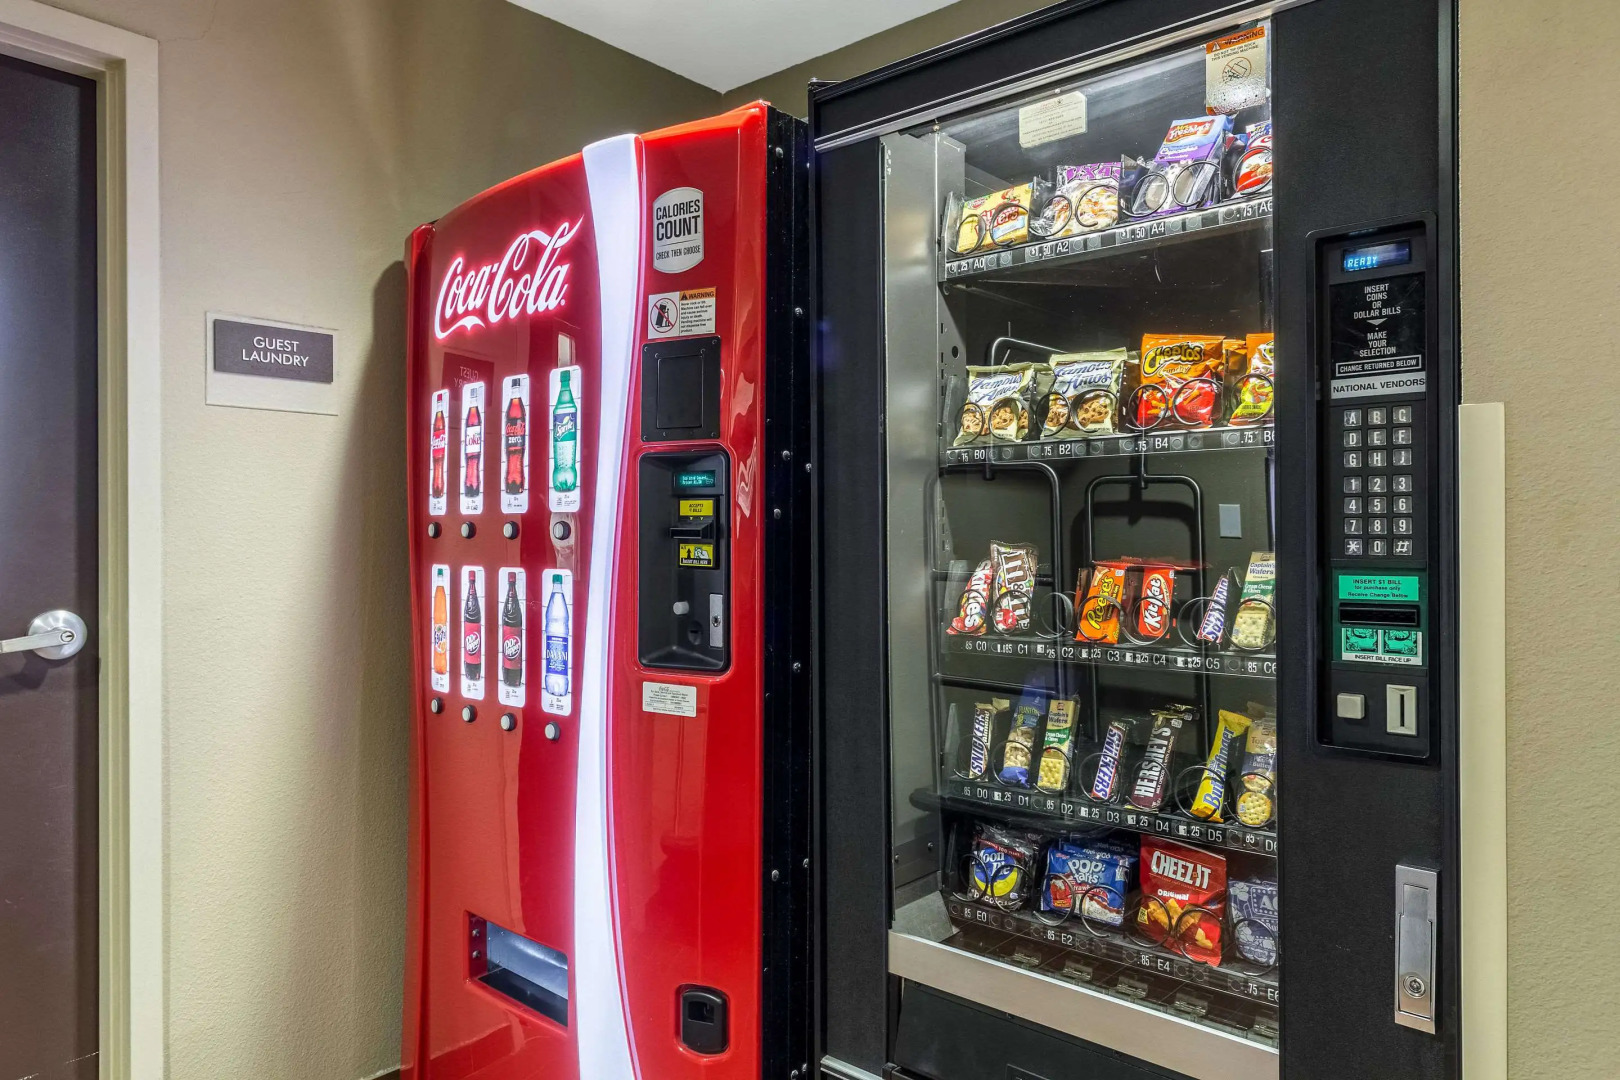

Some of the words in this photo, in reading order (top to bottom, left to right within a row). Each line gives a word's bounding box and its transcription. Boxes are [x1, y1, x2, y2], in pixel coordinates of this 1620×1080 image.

[1224, 28, 1264, 45] WARNING
[656, 199, 700, 221] CALORIES
[656, 215, 700, 242] COUNT
[1151, 222, 1165, 235] A4
[656, 248, 670, 260] CHECK
[670, 246, 682, 258] THEN
[683, 244, 700, 256] CHOOSE
[1056, 240, 1069, 254] A2
[974, 258, 984, 270] A0
[1347, 256, 1378, 267] READY
[434, 214, 584, 339] Coca-Cola
[1364, 283, 1389, 294] INSERT
[688, 291, 714, 299] WARNING
[1366, 292, 1388, 301] COINS
[1372, 301, 1382, 309] OR
[1353, 309, 1380, 319] DOLLAR
[1382, 306, 1401, 315] BILLS
[1367, 331, 1387, 340] MAKE
[253, 336, 300, 352] GUEST
[1368, 339, 1387, 348] YOUR
[1359, 346, 1396, 357] SELECTION
[242, 349, 309, 367] LAUNDRY
[1142, 344, 1204, 376] Cheetos
[1055, 361, 1112, 376] Famous
[1340, 364, 1363, 373] CHANGE
[1364, 361, 1395, 370] RETURNED
[971, 373, 1022, 390] Famous
[1062, 374, 1112, 394] Amos
[1333, 383, 1378, 393] NATIONAL
[1380, 378, 1425, 389] VENDORS
[1349, 412, 1356, 424] A
[1373, 411, 1381, 423] B
[556, 423, 575, 437] Sprite
[1398, 430, 1406, 442] F
[1155, 438, 1168, 449] B4
[1349, 433, 1356, 445] D
[1374, 432, 1380, 443] E
[974, 450, 985, 460] B0
[1059, 444, 1071, 455] B2
[1349, 453, 1356, 465] G
[1374, 452, 1381, 465] H
[1400, 451, 1404, 463] J
[1351, 478, 1355, 490] 1
[1374, 478, 1380, 490] 2
[1399, 477, 1405, 489] 3
[1349, 500, 1356, 511] 4
[1374, 499, 1380, 511] 5
[1399, 498, 1406, 510] 6
[1350, 520, 1356, 531] 7
[1374, 520, 1381, 532] 8
[1399, 520, 1406, 531] 9
[1374, 541, 1380, 552] 0
[1396, 541, 1409, 552] #
[1087, 576, 1114, 630] Reese's
[976, 640, 986, 651] C0
[1018, 644, 1028, 654] C1
[547, 649, 568, 661] DASANI
[1062, 647, 1073, 658] C2
[1107, 650, 1119, 661] C3
[1153, 654, 1166, 665] C4
[1206, 658, 1220, 669] C5
[971, 709, 985, 774] SNICKERS
[1094, 728, 1122, 799] SNICKERS
[1134, 727, 1171, 798] HERSHEY'S
[977, 788, 988, 798] D0
[1018, 795, 1029, 806] D1
[1061, 803, 1073, 814] D2
[1107, 811, 1119, 823] D3
[1156, 820, 1169, 832] D4
[1208, 829, 1222, 842] D5
[1074, 872, 1099, 883] tarts
[977, 911, 986, 922] E0
[1062, 933, 1072, 945] E2
[1157, 960, 1170, 972] E4
[1245, 983, 1258, 995] .75
